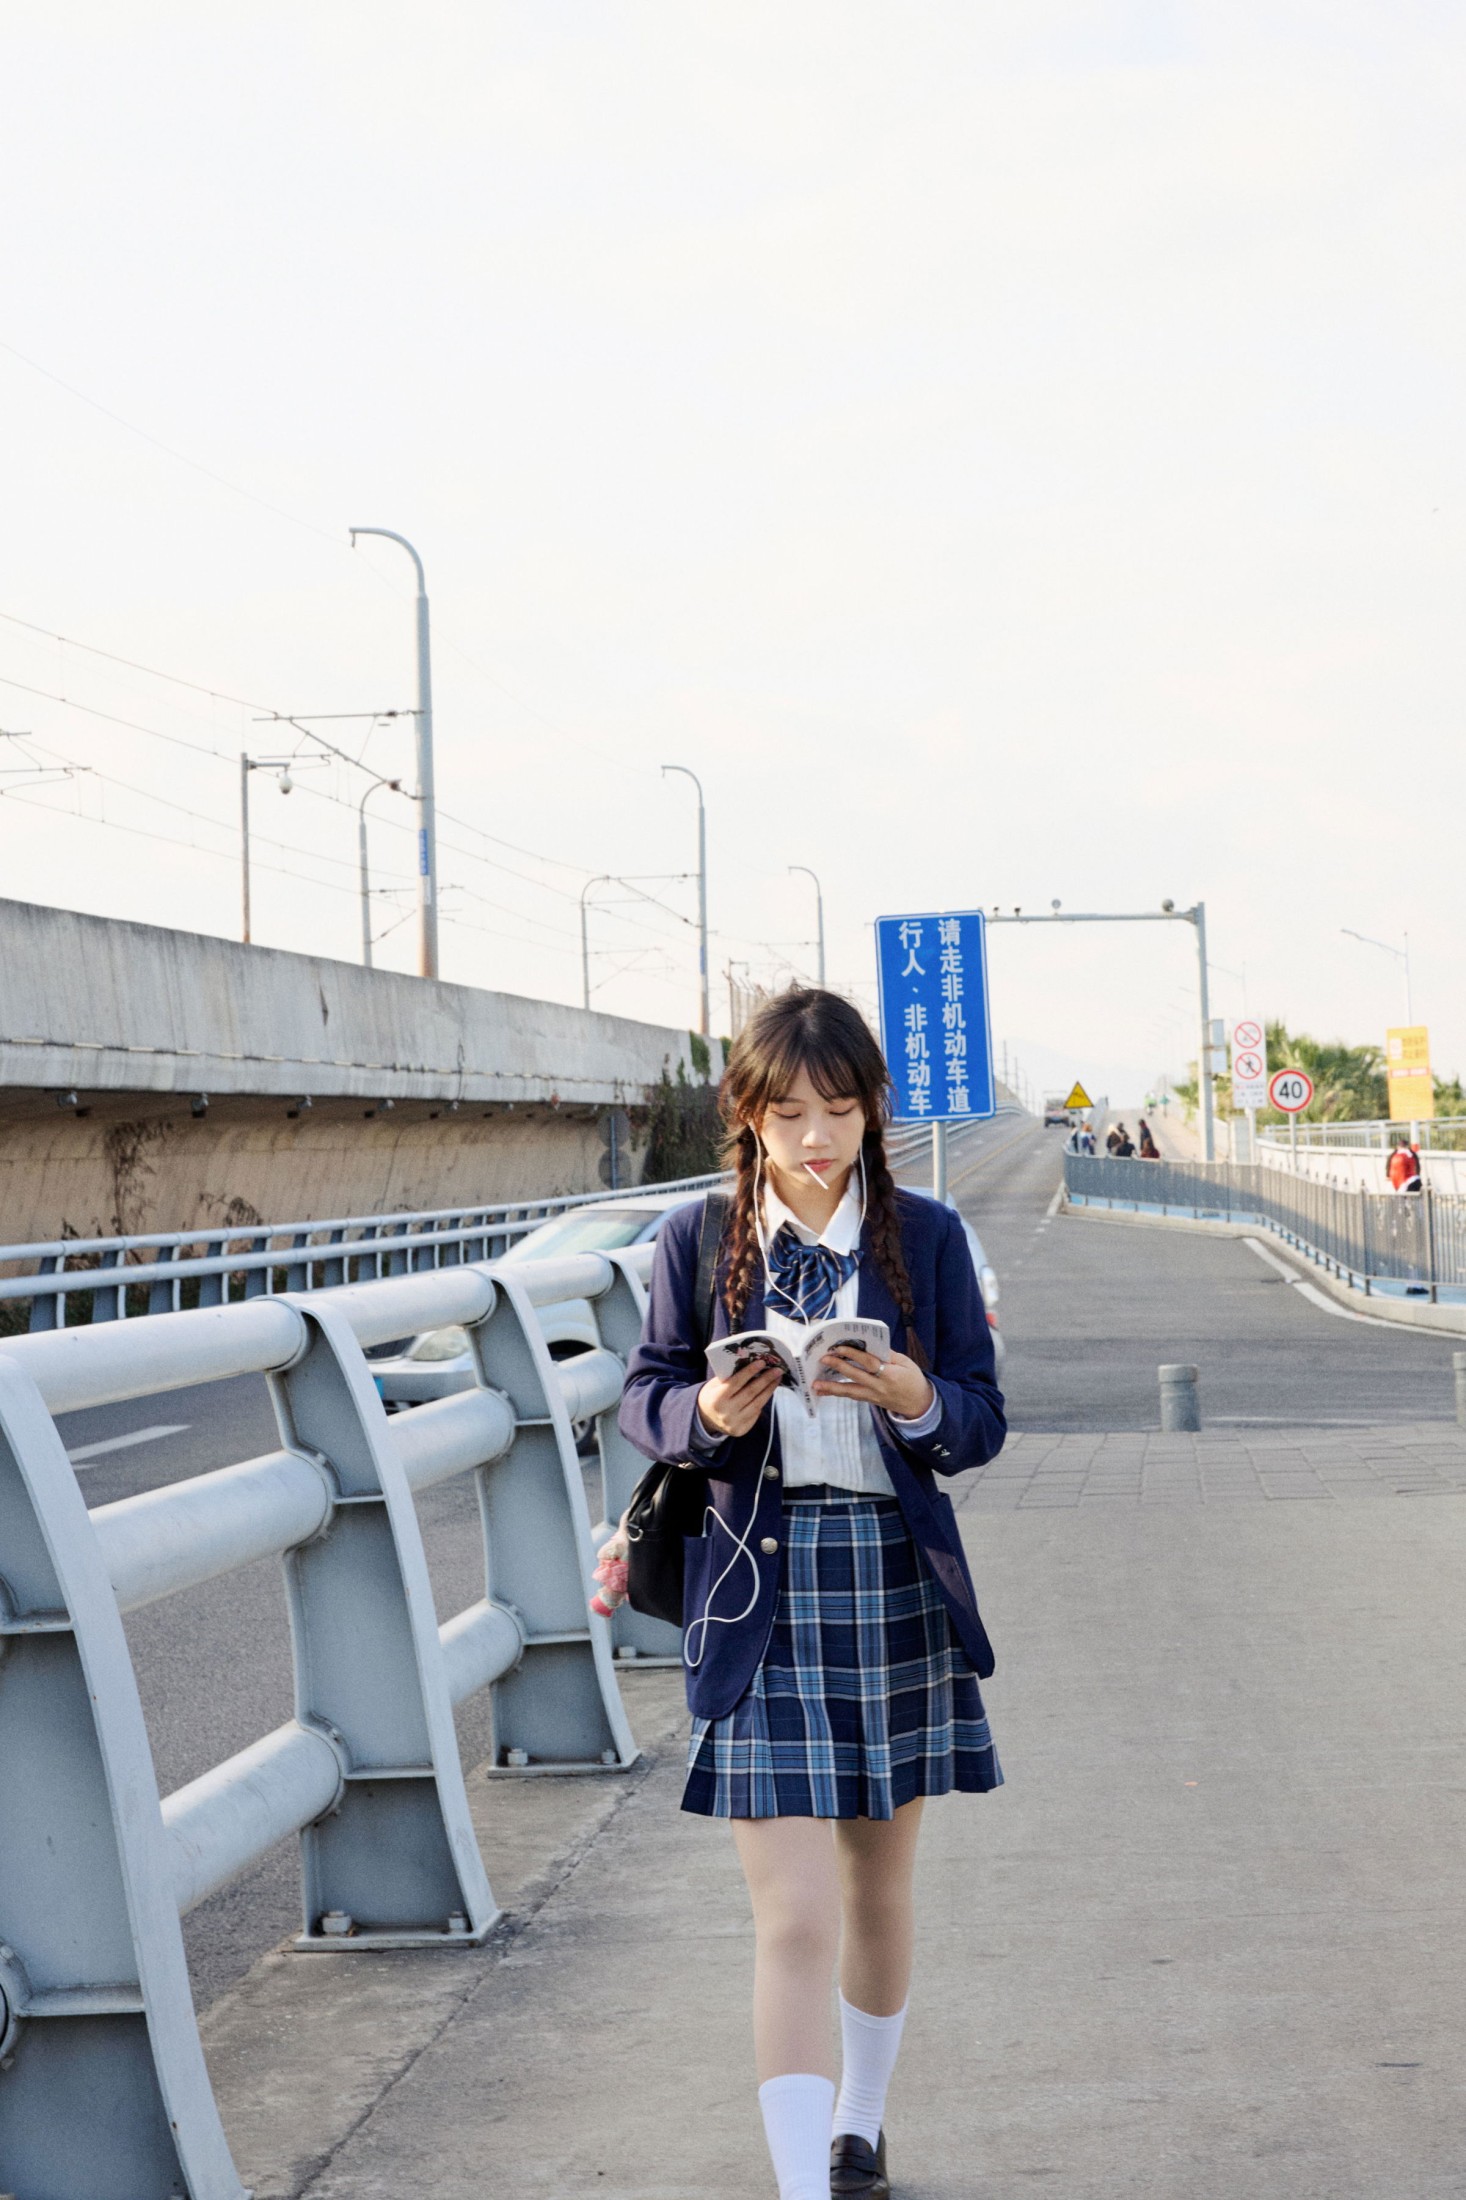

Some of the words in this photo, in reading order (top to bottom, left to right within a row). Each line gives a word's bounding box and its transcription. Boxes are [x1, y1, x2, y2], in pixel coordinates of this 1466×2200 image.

[899, 921, 932, 1115] 行人、非机动车
[938, 918, 971, 1113] 请走非机动车道
[1279, 1081, 1303, 1099] 40
